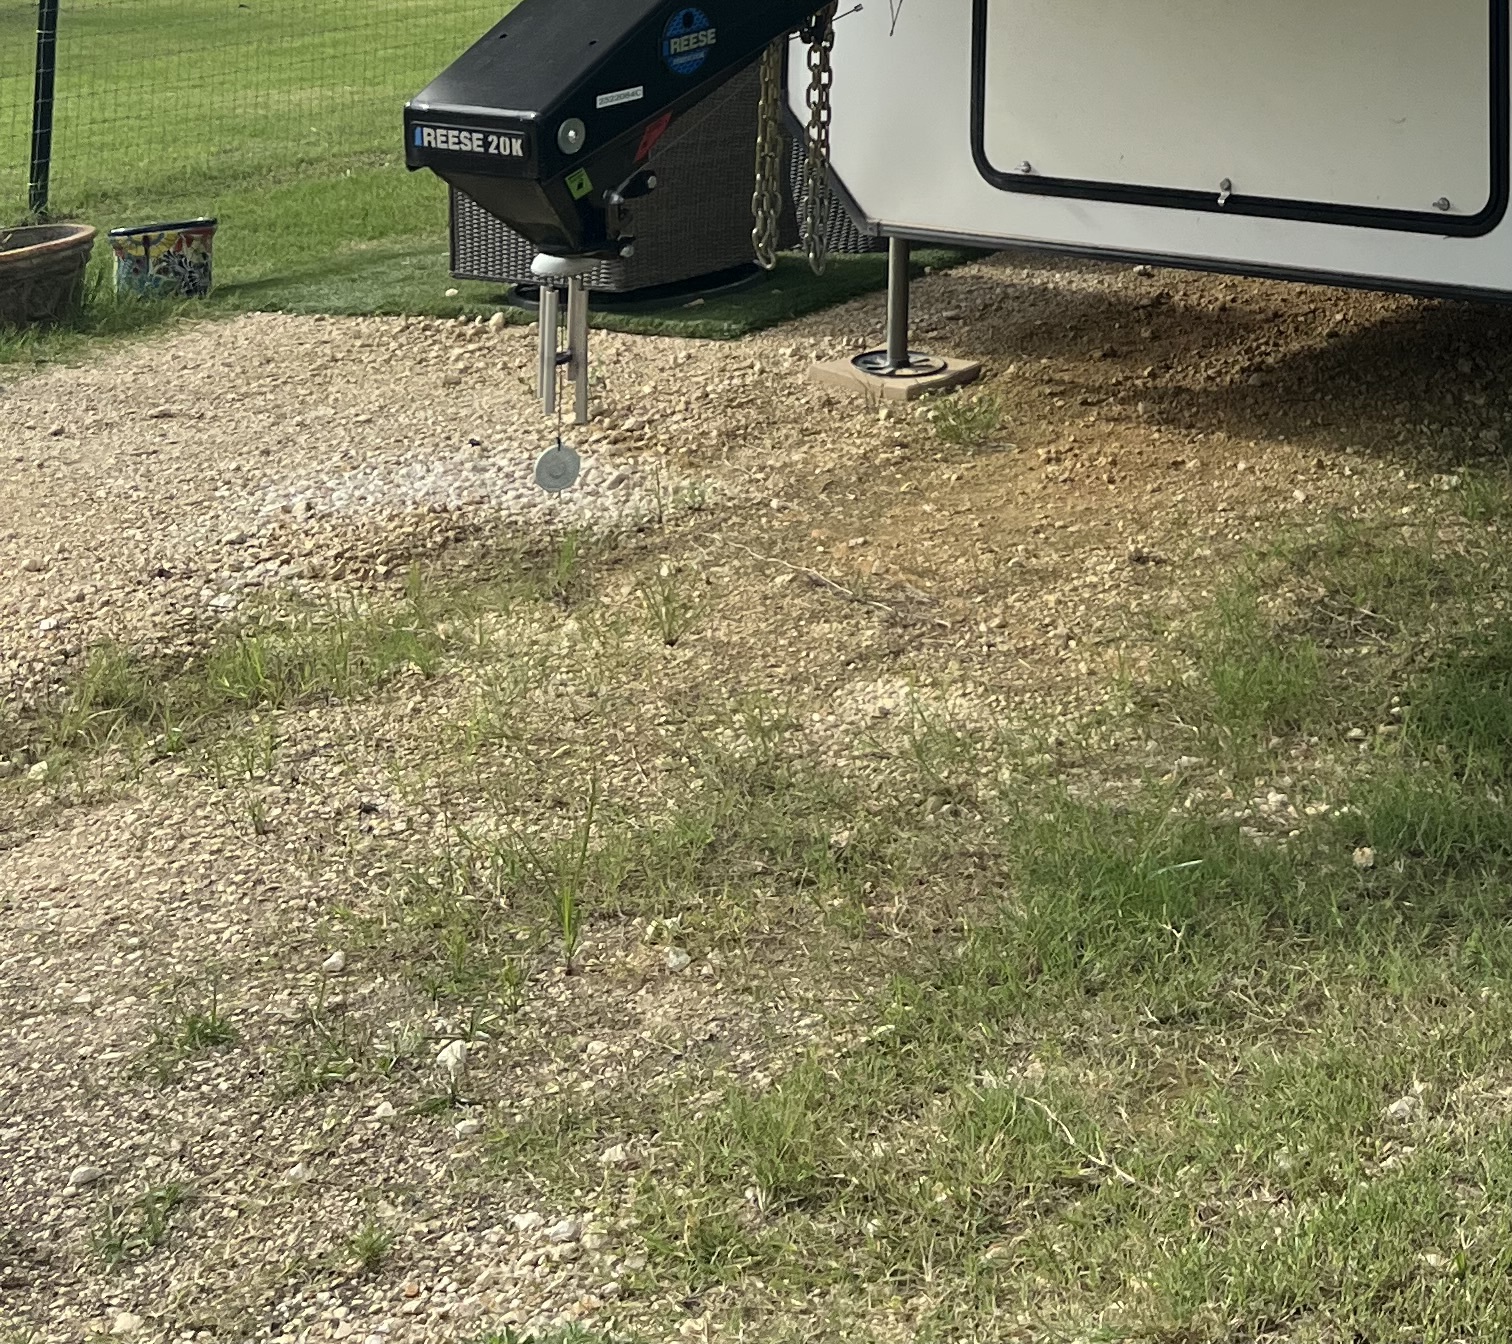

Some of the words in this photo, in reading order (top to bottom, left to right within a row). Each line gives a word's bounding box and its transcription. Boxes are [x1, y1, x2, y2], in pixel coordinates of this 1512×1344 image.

[670, 28, 717, 55] REESE
[422, 127, 485, 153] REESE
[487, 135, 524, 157] 20K
